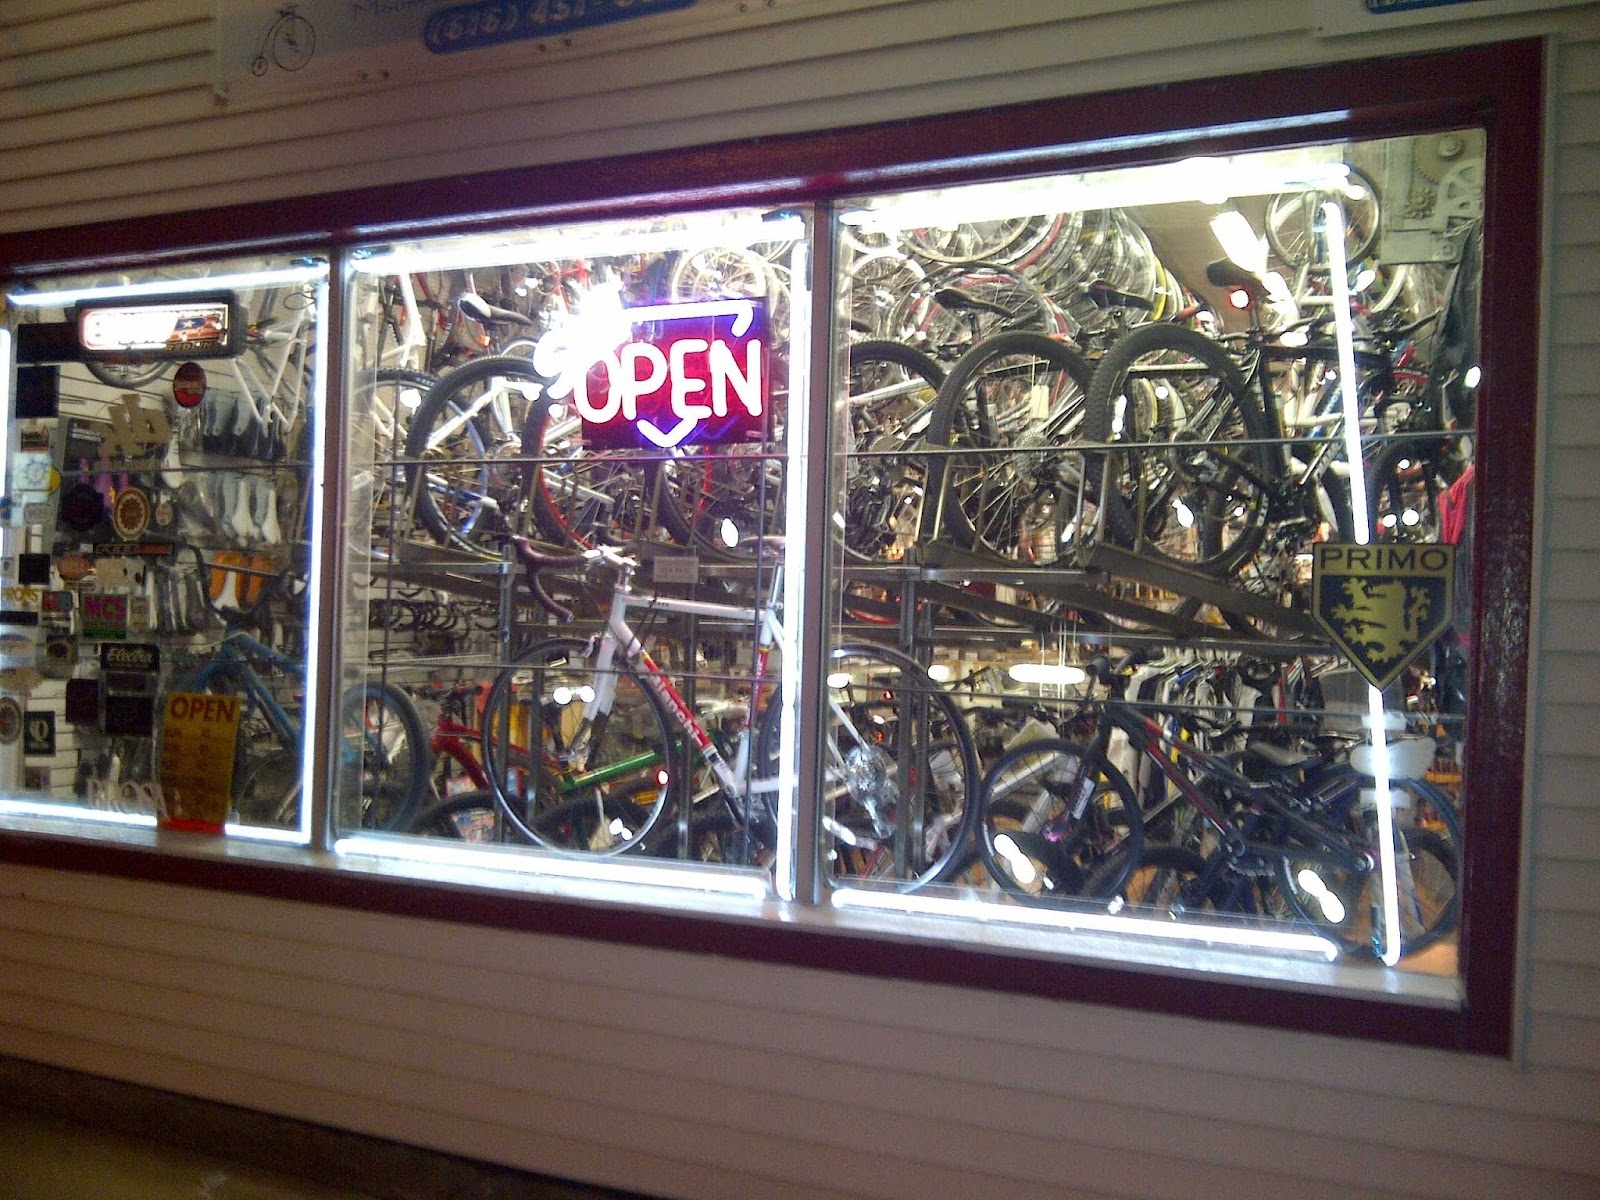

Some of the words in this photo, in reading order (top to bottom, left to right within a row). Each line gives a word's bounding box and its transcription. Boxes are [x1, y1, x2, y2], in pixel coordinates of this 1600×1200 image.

[573, 338, 763, 424] OPEN
[1320, 548, 1448, 571] PRIMO
[106, 647, 155, 664] Electra
[170, 696, 237, 723] OPEN
